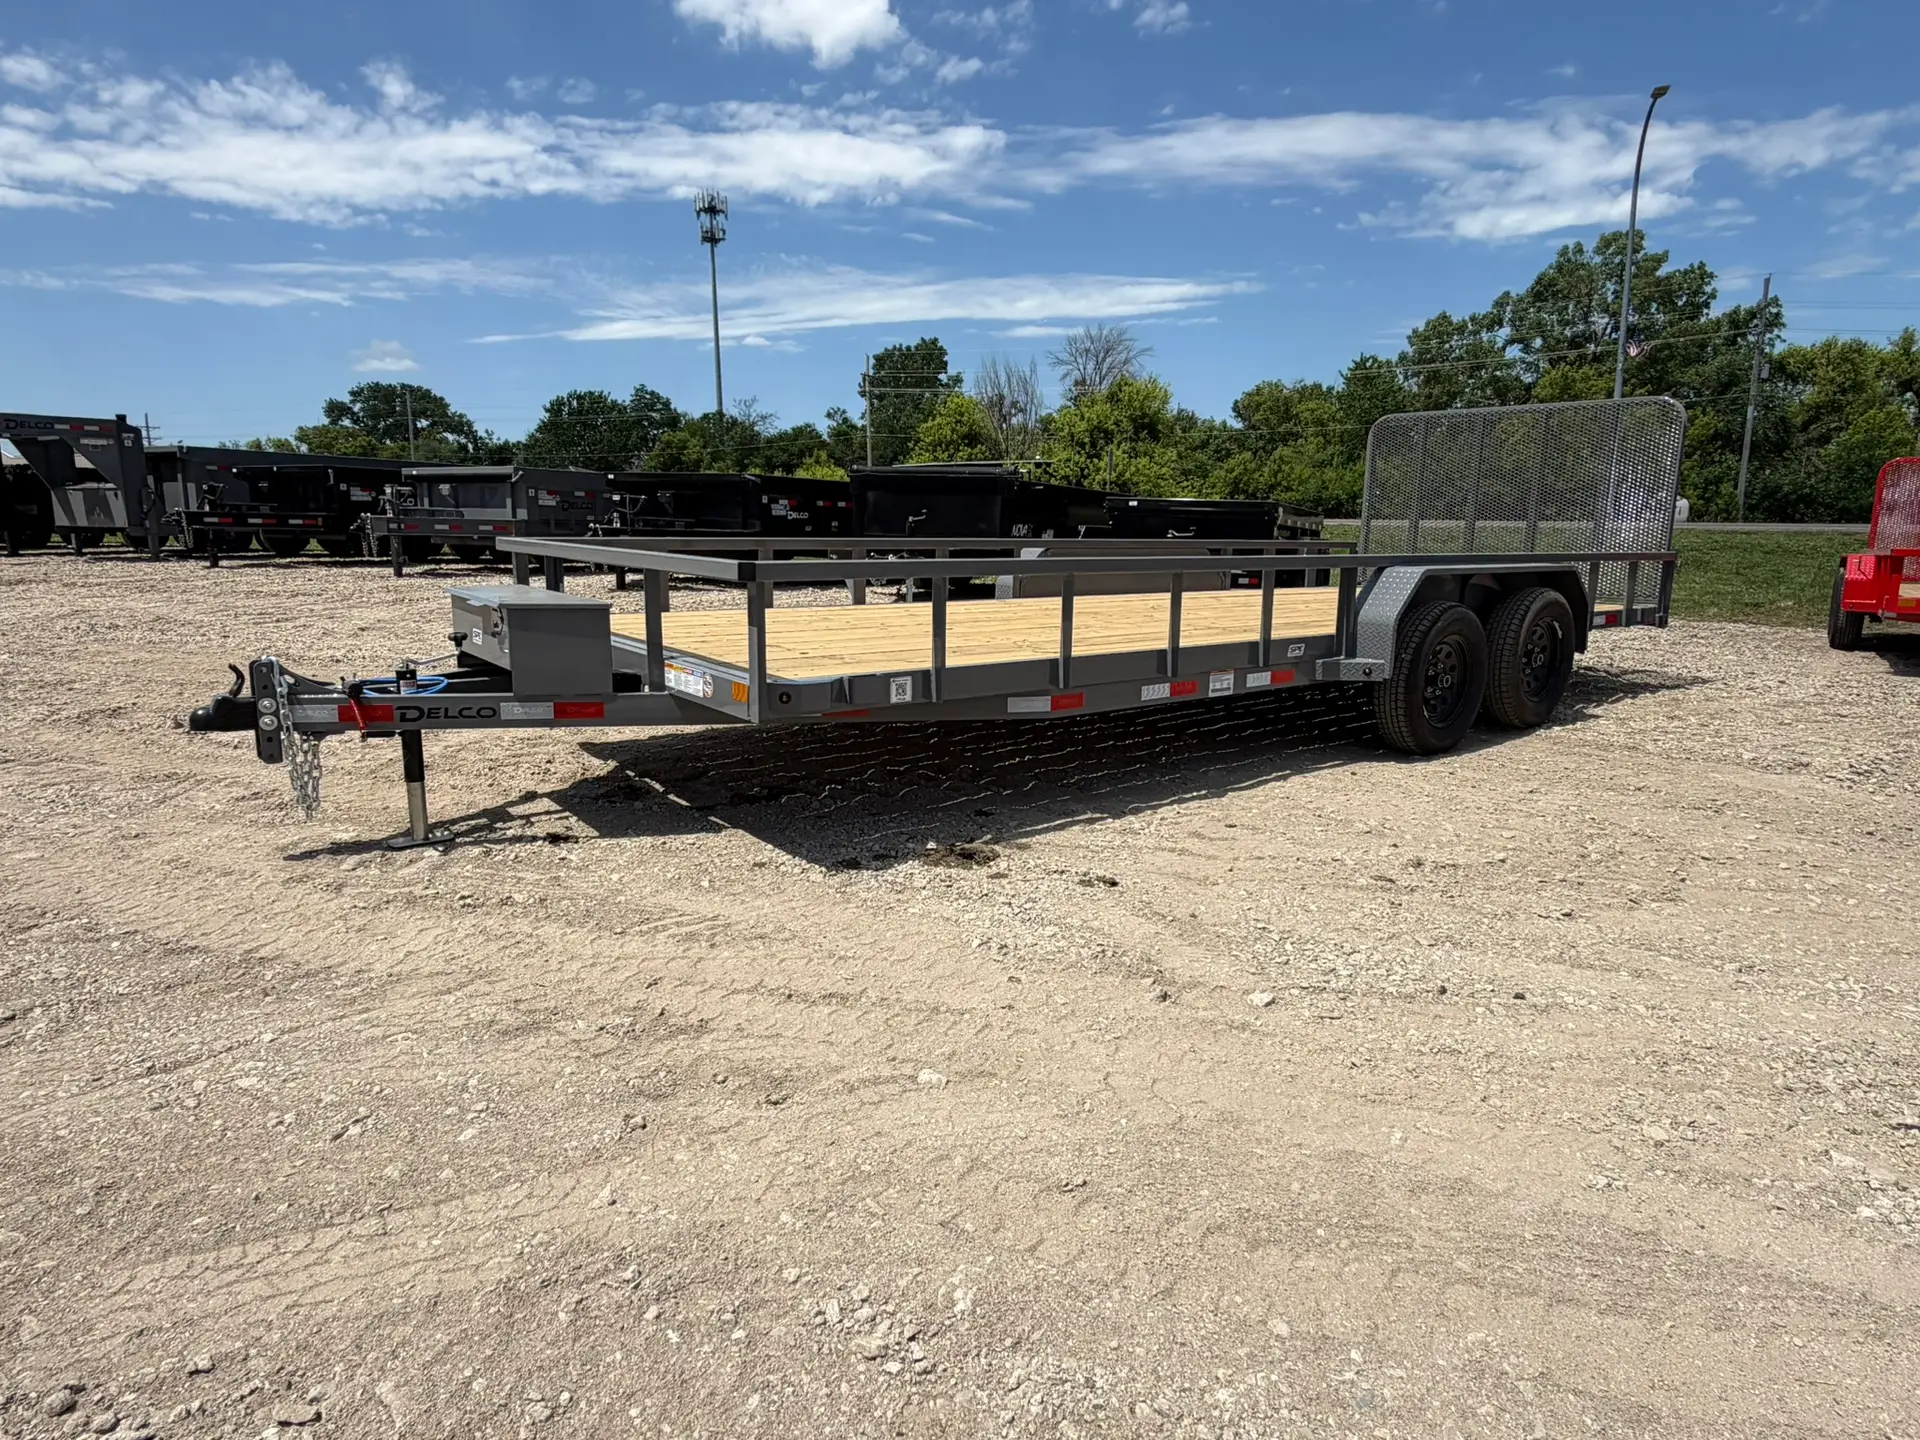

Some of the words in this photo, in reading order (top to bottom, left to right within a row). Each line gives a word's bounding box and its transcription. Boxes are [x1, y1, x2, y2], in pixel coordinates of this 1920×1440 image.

[3, 419, 54, 430] DELCO
[787, 511, 809, 520] DELCO
[394, 706, 497, 723] DELCO
